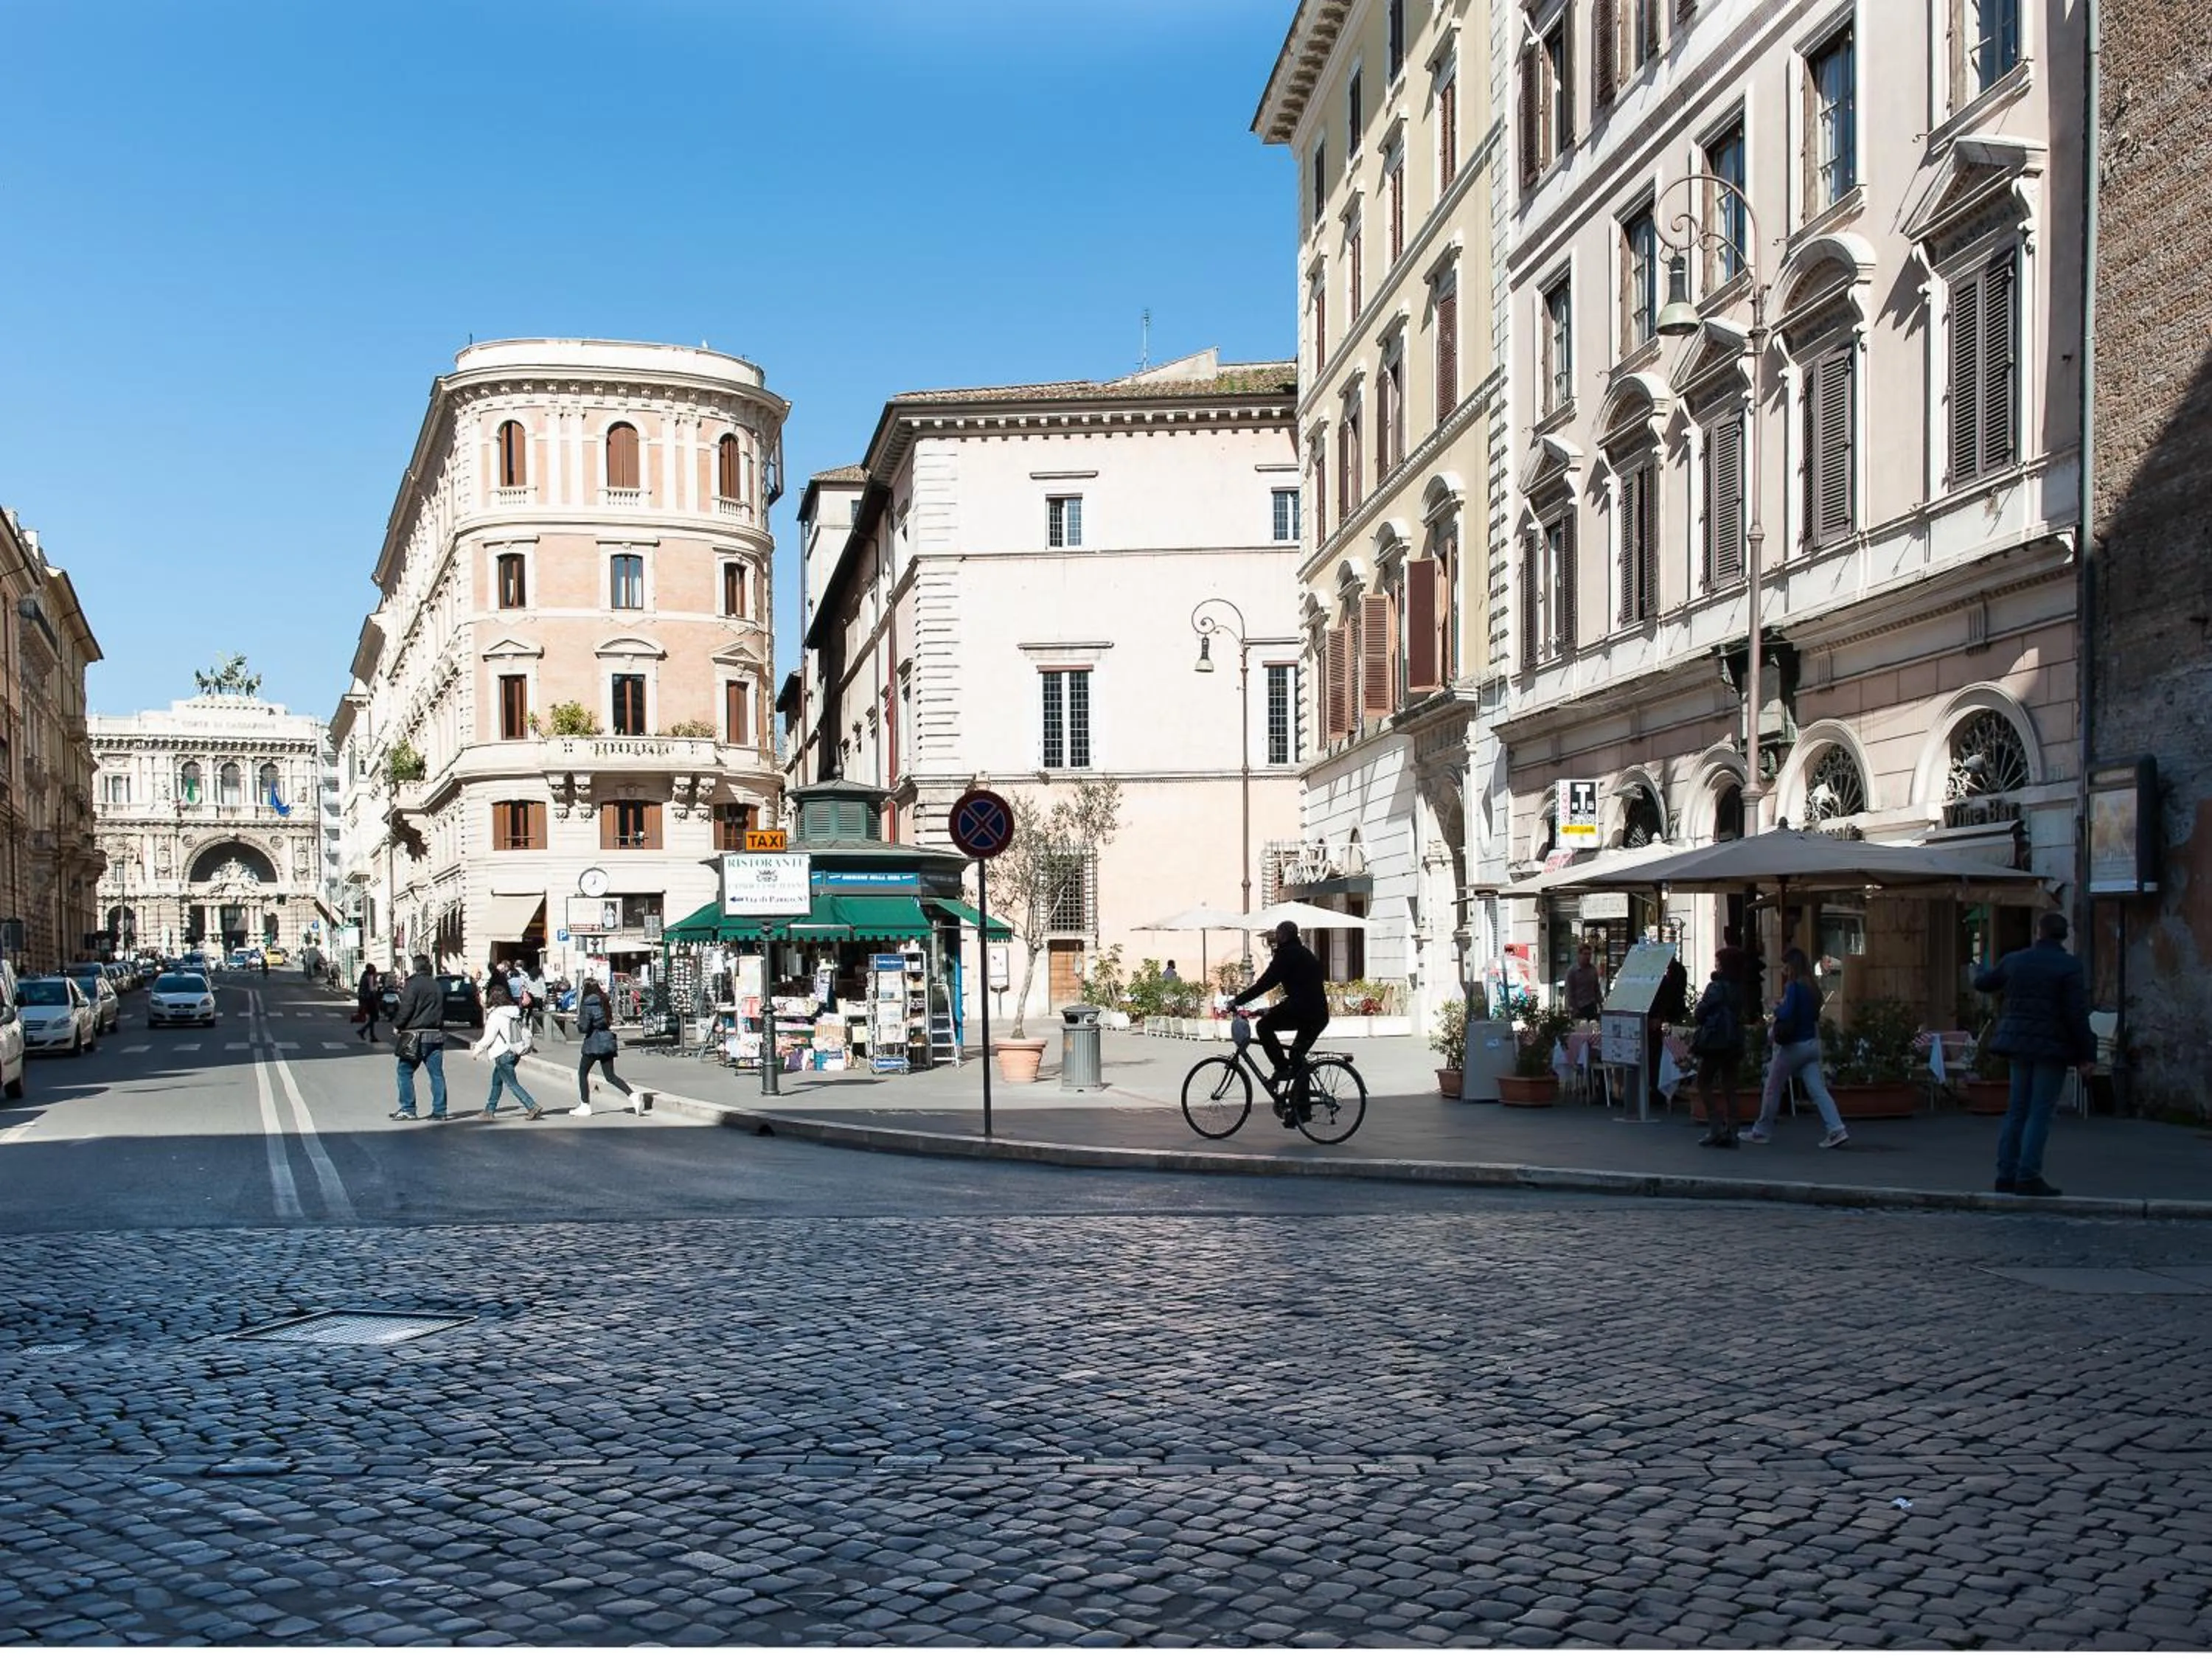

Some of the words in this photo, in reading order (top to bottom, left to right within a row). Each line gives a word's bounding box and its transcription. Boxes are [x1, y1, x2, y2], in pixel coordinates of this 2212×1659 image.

[1575, 784, 1591, 810] T
[1942, 801, 1983, 827] Wine
[1986, 798, 2018, 822] Bar
[748, 835, 784, 847] TAXI
